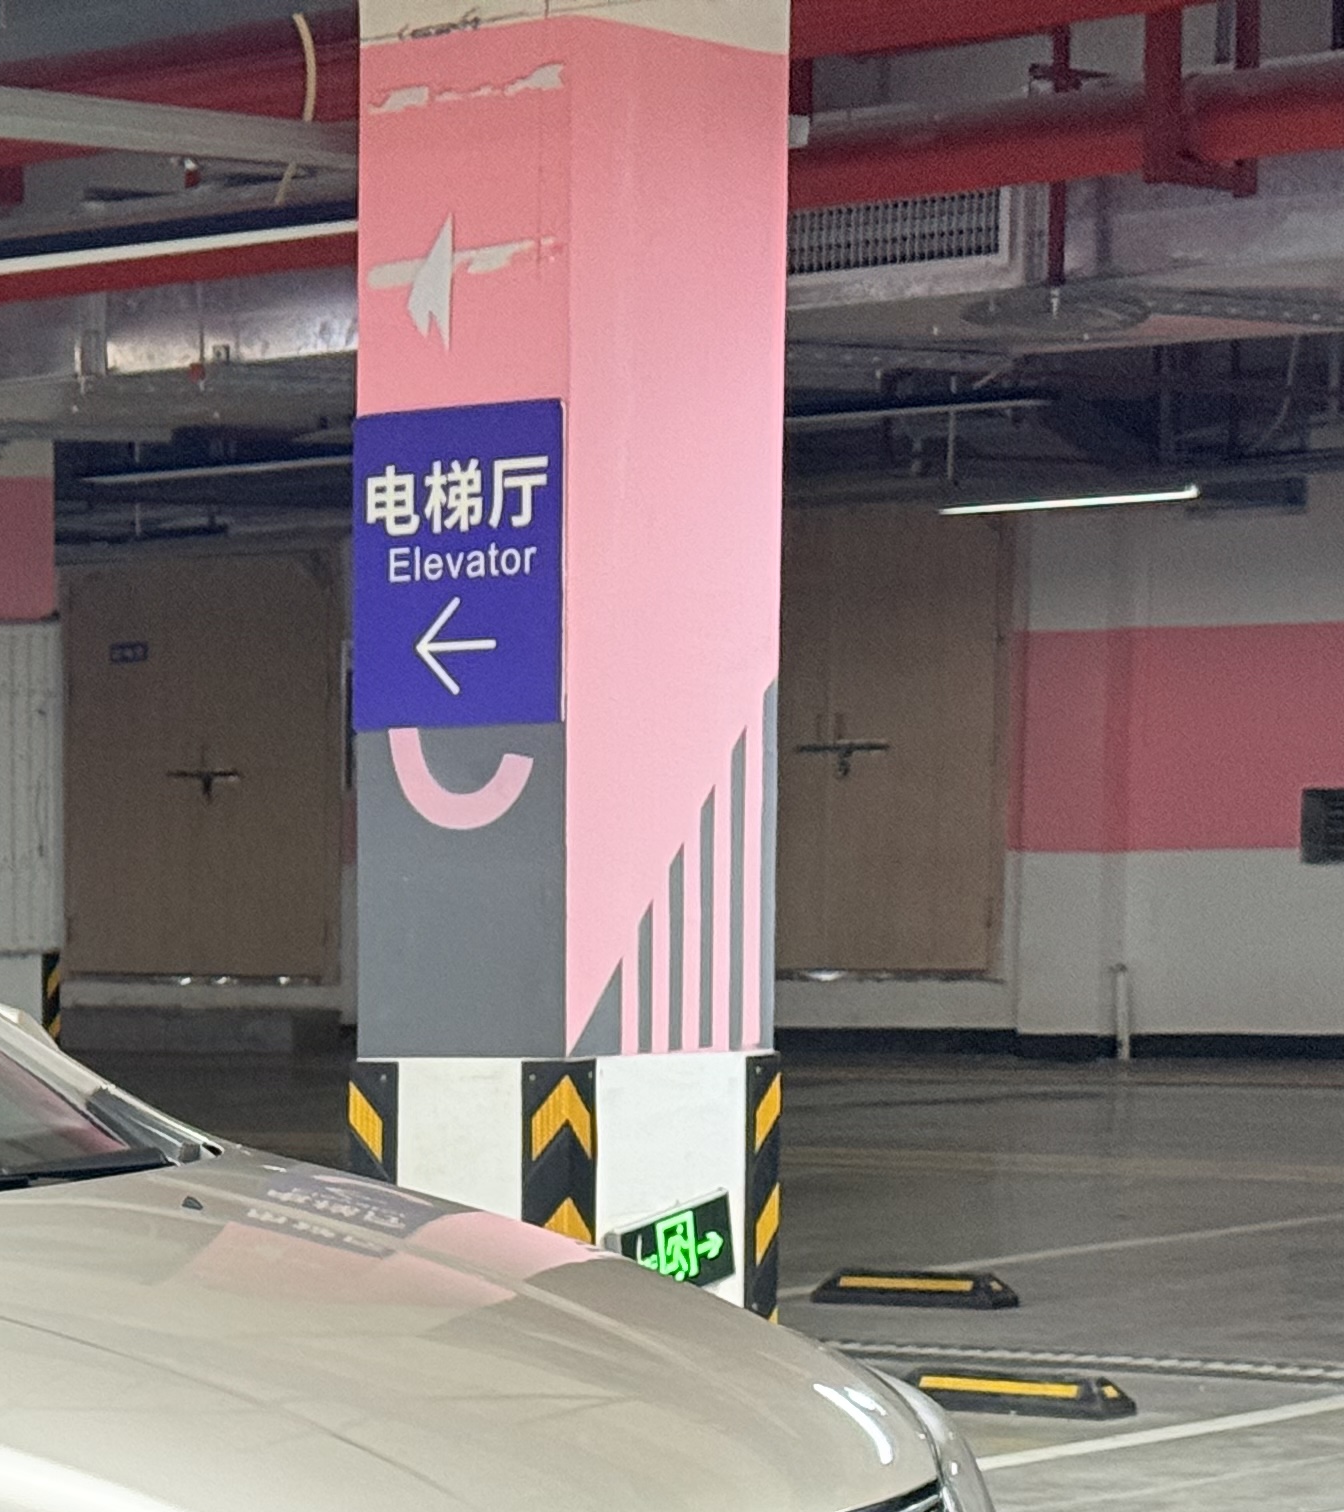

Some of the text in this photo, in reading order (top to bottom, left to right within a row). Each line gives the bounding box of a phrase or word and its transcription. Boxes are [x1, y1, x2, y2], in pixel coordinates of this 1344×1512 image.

[365, 455, 549, 537] 电梯厅
[387, 542, 538, 584] Elevator
